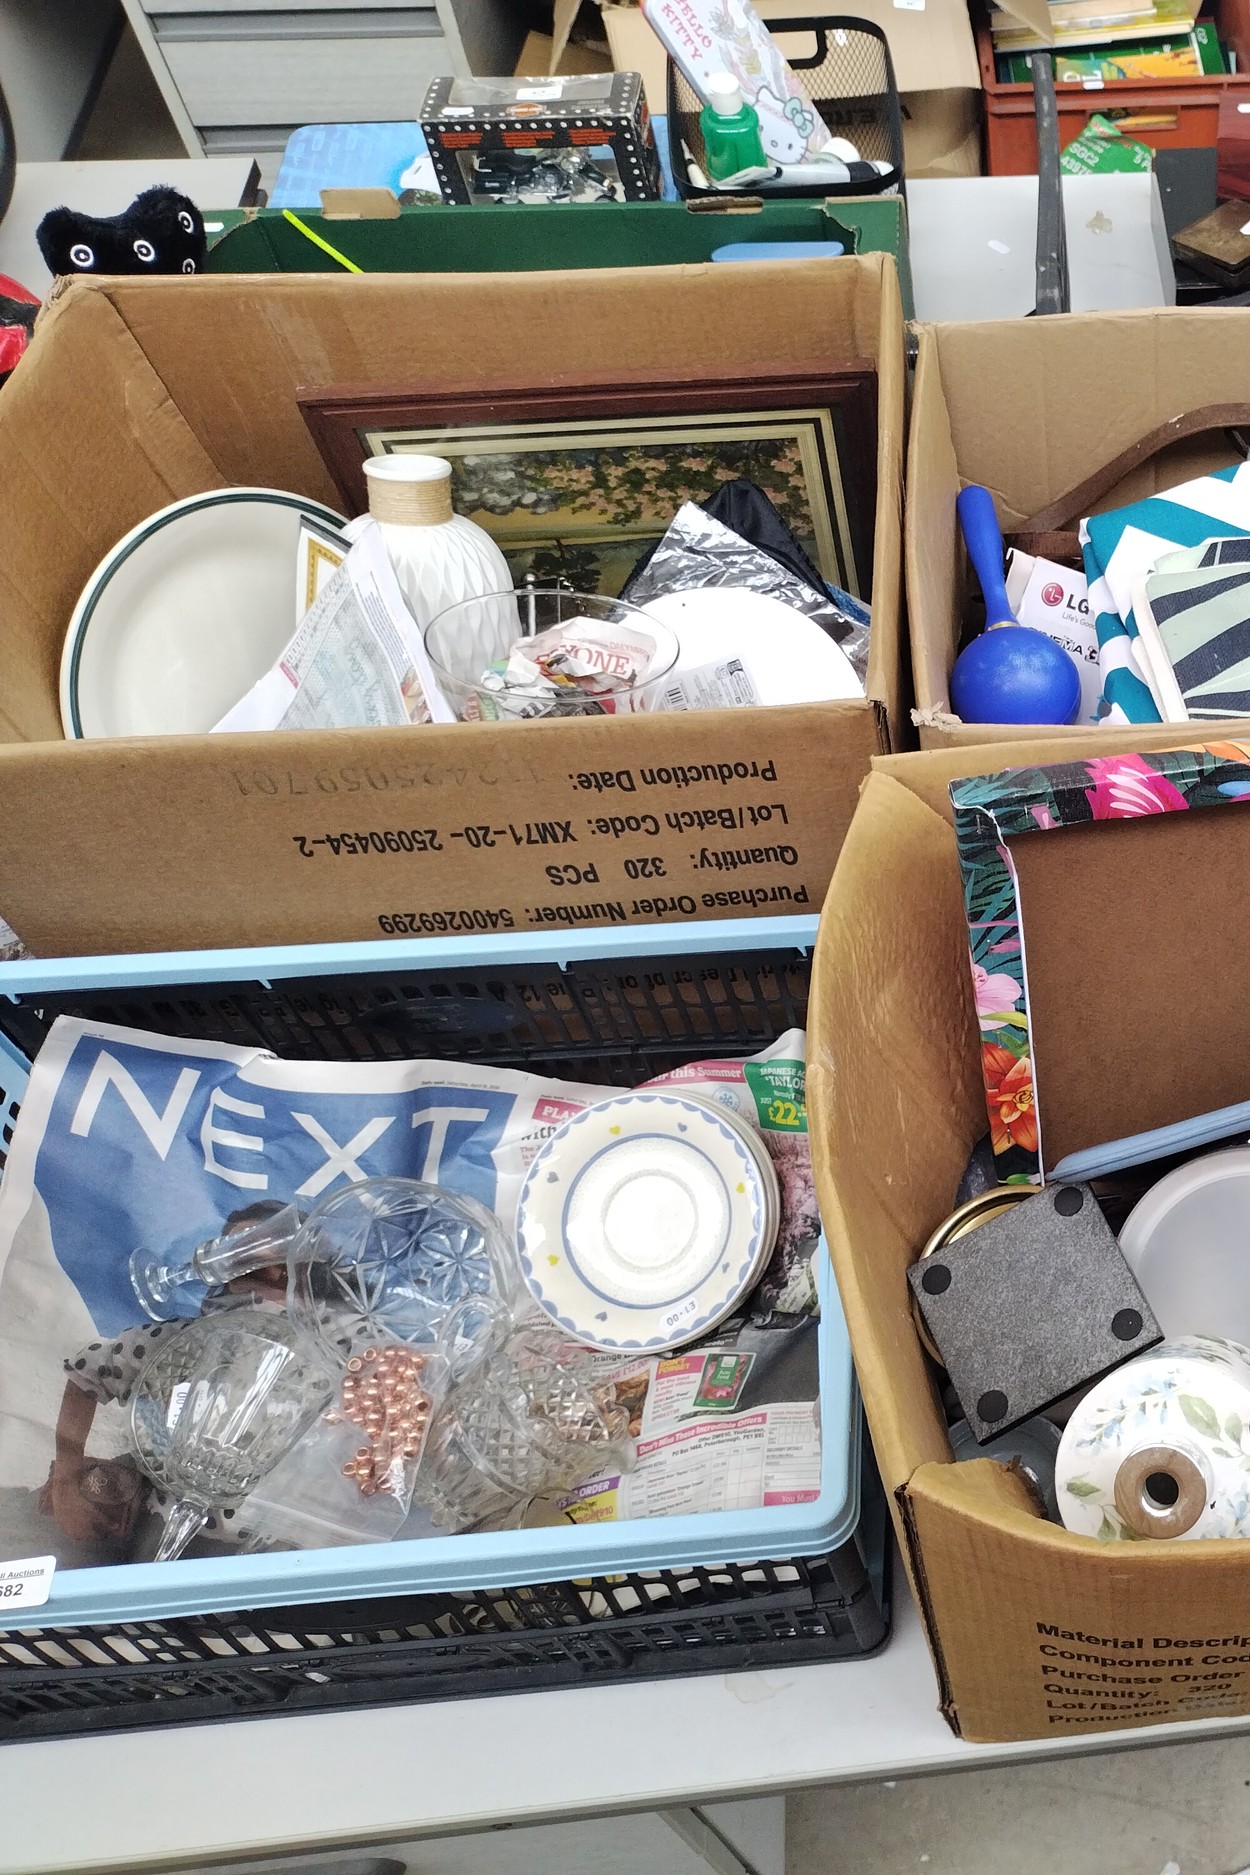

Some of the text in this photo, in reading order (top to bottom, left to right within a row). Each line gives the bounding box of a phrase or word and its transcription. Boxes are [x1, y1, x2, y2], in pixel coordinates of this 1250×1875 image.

[661, 3, 703, 60] KITTY
[1066, 593, 1089, 615] LG
[568, 769, 636, 793] Date:
[641, 760, 777, 789] Production
[586, 814, 660, 838] Code:
[293, 828, 443, 857] 25090454-2
[545, 845, 798, 886] Quantity: 320 PCS
[378, 884, 809, 934] Purchase Order Number: 5400269299
[671, 1065, 695, 1079] this
[698, 1067, 741, 1078] Summer
[760, 1067, 797, 1076] JAPANESE
[70, 1050, 490, 1198] NEXT
[639, 1441, 658, 1454] Don't
[696, 1421, 737, 1435] Incredible
[737, 1416, 763, 1428] Offers
[579, 1481, 610, 1497] ORDER
[782, 1495, 796, 1503] You
[7, 1568, 45, 1579] Auctions
[1036, 1622, 1143, 1649] Material
[1039, 1644, 1193, 1667] Component
[1041, 1665, 1163, 1685] Purchase
[1170, 1670, 1246, 1683] Order
[1043, 1683, 1160, 1699] Quantity:
[1046, 1699, 1170, 1711] Lot/Batch
